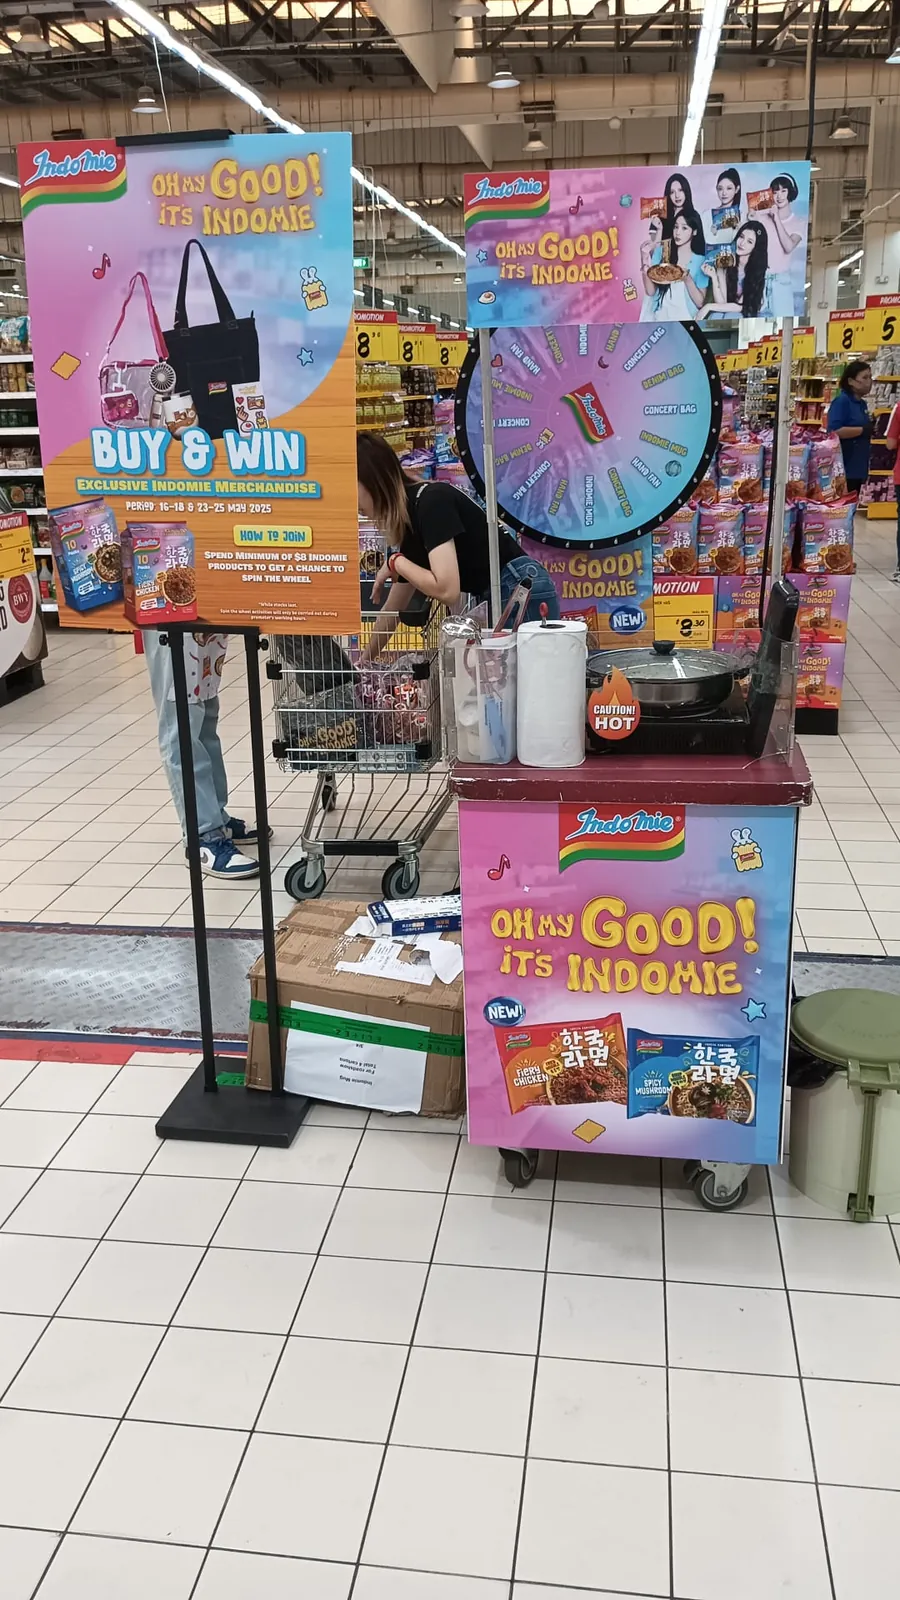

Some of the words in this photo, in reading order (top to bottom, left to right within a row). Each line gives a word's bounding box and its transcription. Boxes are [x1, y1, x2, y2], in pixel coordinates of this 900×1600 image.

[152, 172, 180, 197] OH
[182, 175, 205, 193] MY
[210, 152, 323, 202] GOOD!
[202, 204, 315, 235] INDOMIE
[495, 241, 516, 258] OH
[517, 242, 536, 255] MY
[538, 227, 619, 262] GOOD!
[531, 262, 612, 285] INDOMIE
[882, 316, 896, 341] 5
[358, 332, 370, 358] 8
[606, 330, 619, 352] HAND
[842, 328, 853, 349] 8
[403, 341, 413, 362] 8
[441, 348, 449, 365] 8
[510, 344, 524, 358] FAN
[624, 342, 651, 371] CONCERT
[650, 328, 665, 343] BAG
[523, 355, 540, 375] HAND
[492, 379, 502, 389] MU
[643, 372, 666, 389] DENIM
[668, 365, 684, 377] BAG
[645, 406, 677, 414] CONCERT
[681, 405, 695, 413] BAG
[498, 418, 529, 427] CONCERT
[91, 429, 167, 470] BUY
[182, 430, 210, 470] &
[223, 430, 300, 471] WIN
[641, 431, 669, 448] INDOMIE
[671, 443, 687, 455] MUG
[526, 461, 550, 487] CONCERT
[632, 457, 649, 476] HAND
[648, 474, 661, 488] FAN
[77, 479, 148, 492] EXCLUSIVE
[152, 480, 211, 493] INDOMIE
[215, 481, 316, 494] MERCHANDISE
[513, 486, 527, 500] BAG
[556, 480, 568, 498] HAND
[609, 468, 626, 499] CONCERT
[621, 501, 632, 516] BAG
[159, 503, 185, 512] 16-18
[188, 503, 194, 512] &
[198, 503, 225, 513] 23-25
[250, 504, 272, 513] 2025
[548, 500, 559, 515] FAN
[240, 530, 263, 541] HOW
[204, 551, 233, 559] SPEND
[236, 552, 279, 560] MINIMUM
[294, 552, 307, 561] $8
[309, 553, 347, 561] INDOMIE
[550, 562, 566, 573] MY
[569, 551, 644, 578] GOOD!
[208, 563, 253, 571] PRODUCTS
[269, 564, 285, 572] GET
[287, 564, 294, 572] A
[562, 580, 637, 598] INDOMIE
[653, 581, 700, 594] MOTION
[13, 592, 29, 606] BWY
[613, 612, 644, 627] NEW!
[594, 705, 635, 714] CAUTION!
[595, 717, 635, 730] HOT
[491, 907, 535, 940] OH
[538, 913, 574, 938] MY
[581, 895, 759, 956] GOOD!
[567, 953, 743, 996] INDOMIE
[488, 1004, 524, 1021] NEW!
[560, 1028, 603, 1050] 한국
[340, 1057, 358, 1066] cartons
[561, 1045, 609, 1068] 라면
[693, 1042, 738, 1066] 한국
[340, 1064, 365, 1072] roadshow
[690, 1065, 741, 1085] 라면
[514, 1074, 549, 1087] CHICKEN
[644, 1079, 661, 1087] SPICY
[636, 1087, 672, 1095] MUSHROOM
